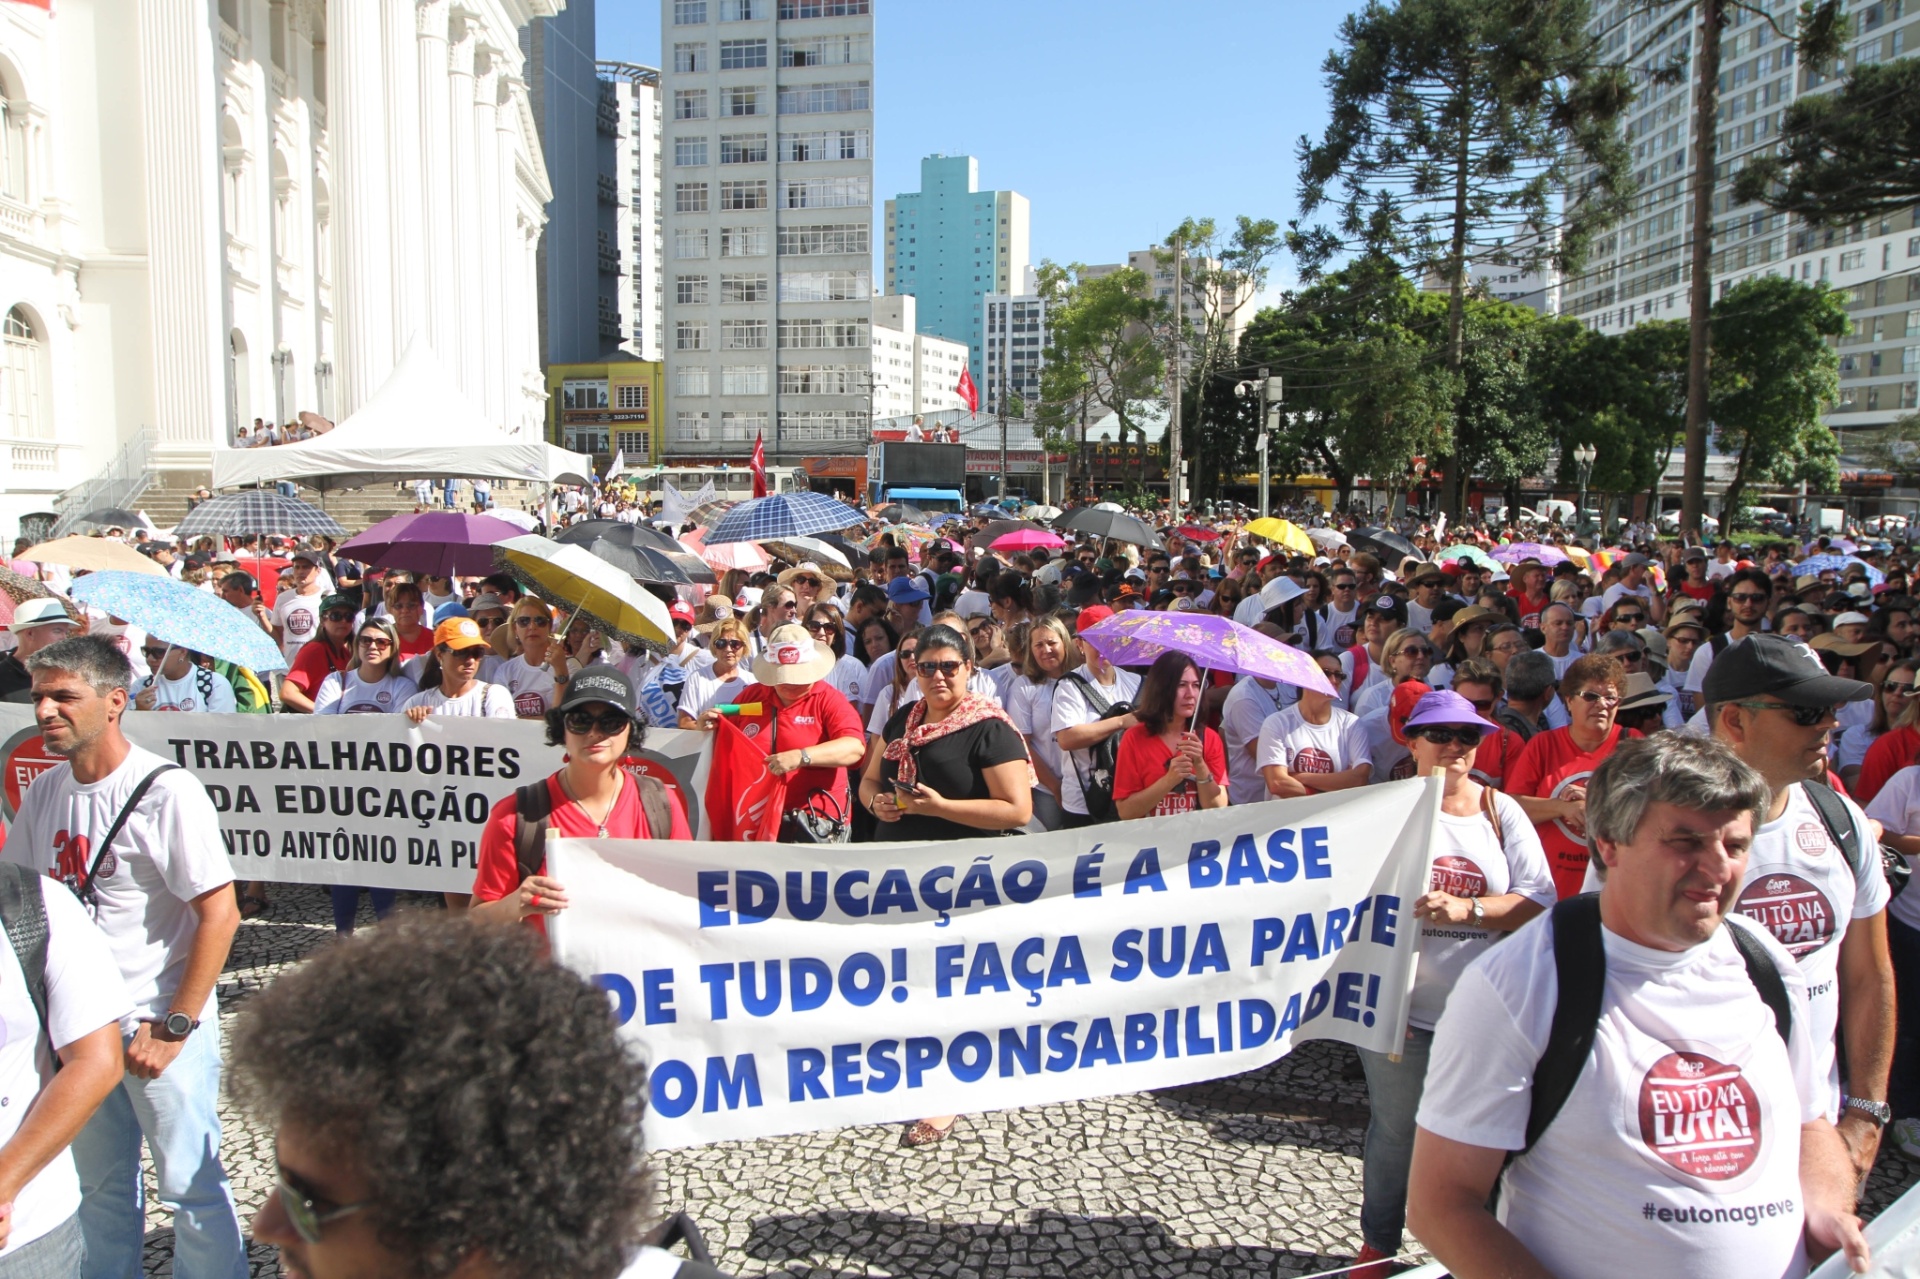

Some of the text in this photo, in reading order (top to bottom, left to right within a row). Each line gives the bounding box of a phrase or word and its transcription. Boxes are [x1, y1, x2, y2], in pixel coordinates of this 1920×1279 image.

[168, 738, 521, 780] TRABALHADORES
[276, 784, 490, 829] EDUCAÇÃO
[221, 826, 479, 870] NTO ANTÔNIO DA PL
[697, 826, 1333, 929] EDUCAÇÃO É A BASE
[1465, 878, 1481, 891] NA
[1774, 880, 1791, 890] APP
[1770, 900, 1795, 925] TÔ
[1798, 900, 1826, 920] NA
[1770, 917, 1827, 944] UTA!
[1422, 927, 1489, 942] eutonagreve
[590, 894, 1401, 1028] DE TUDO! FAÇA SUA PARTE
[648, 971, 1382, 1119] OM RESPONSABILIDADE!
[1651, 1081, 1746, 1114] EU TÔ NA
[1654, 1105, 1752, 1146] LUTA!
[1642, 1198, 1794, 1227] #eutonagreve
